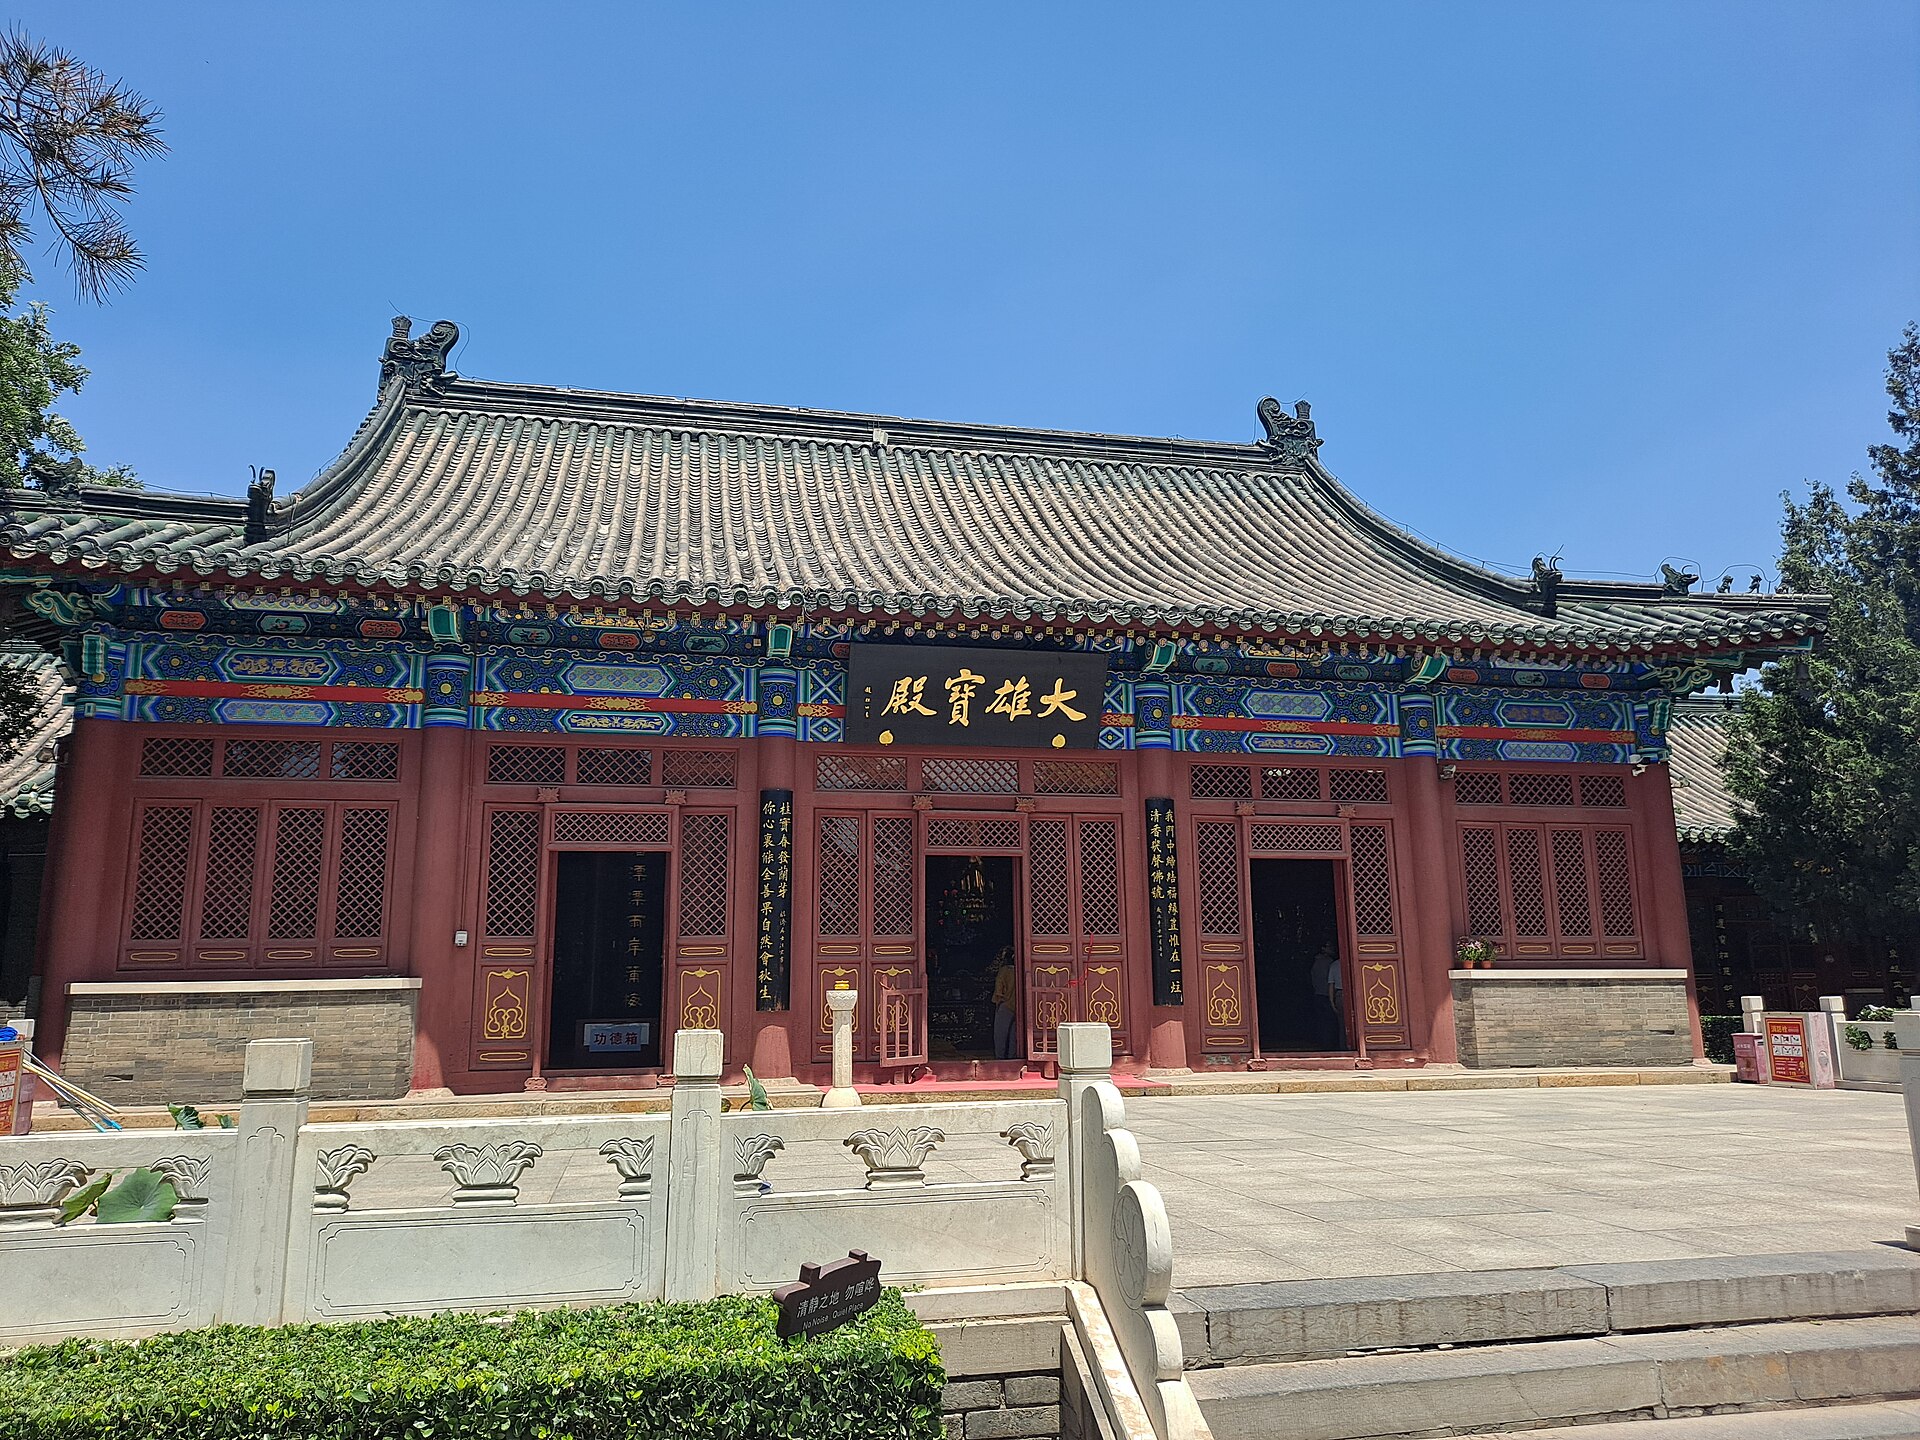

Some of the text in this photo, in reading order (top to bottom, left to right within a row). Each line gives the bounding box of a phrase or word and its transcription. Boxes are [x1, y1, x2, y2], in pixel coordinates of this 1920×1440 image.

[593, 1031, 639, 1046] 功德箱
[796, 1277, 875, 1319] 清静之地 勿喧哗
[802, 1320, 812, 1330] No
[812, 1315, 829, 1327] Noise
